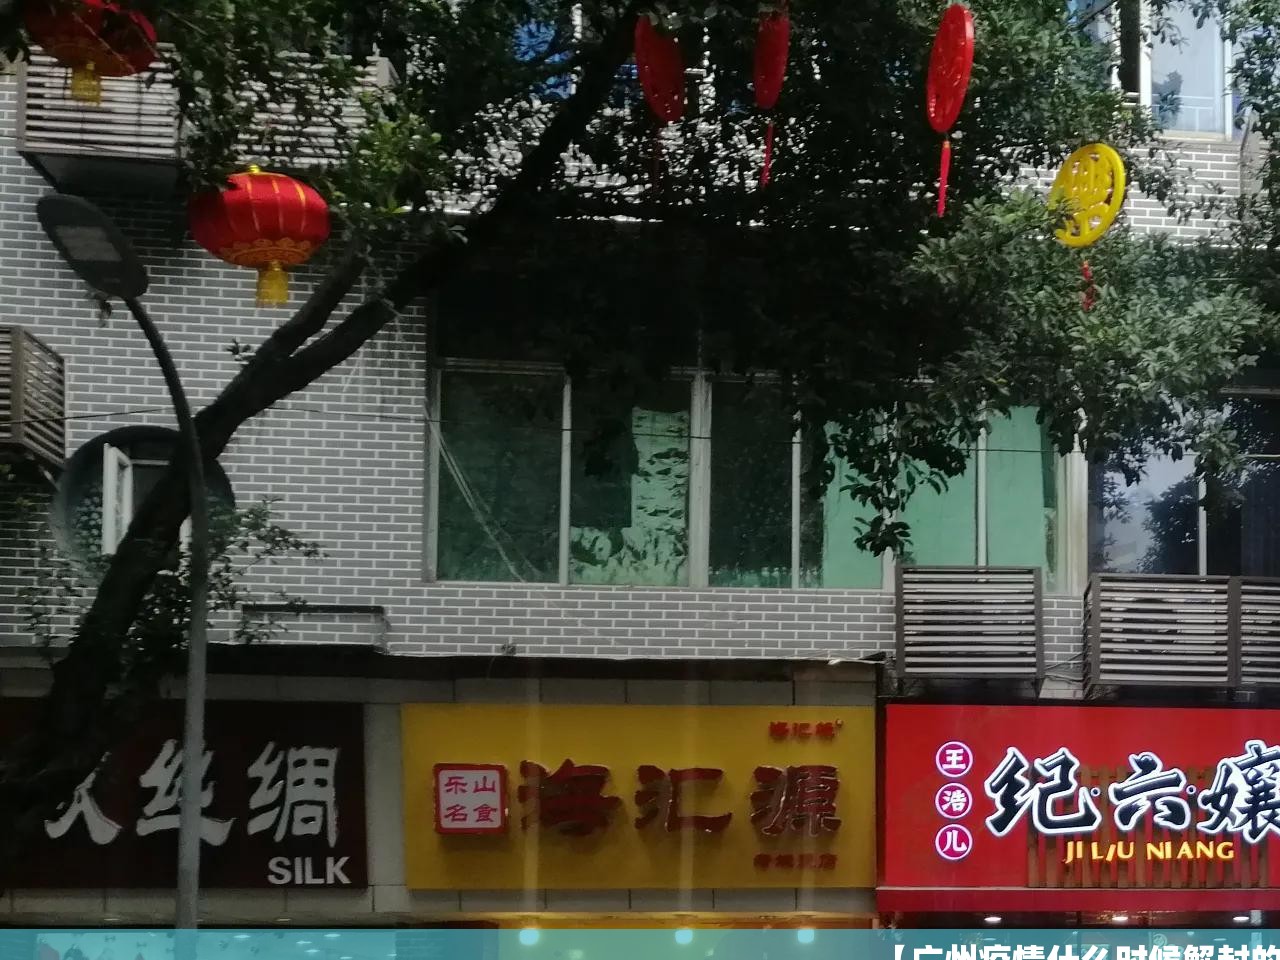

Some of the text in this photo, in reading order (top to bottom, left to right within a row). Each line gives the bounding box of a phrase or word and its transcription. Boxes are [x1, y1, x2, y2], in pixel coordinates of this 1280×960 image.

[443, 775, 497, 795] 乐山
[517, 758, 842, 838] 海汇源
[443, 803, 498, 824] 名食
[935, 740, 974, 861] 王浩儿
[1061, 841, 1083, 864] JI
[1146, 840, 1235, 862] NIANG
[267, 856, 351, 885] SILK
